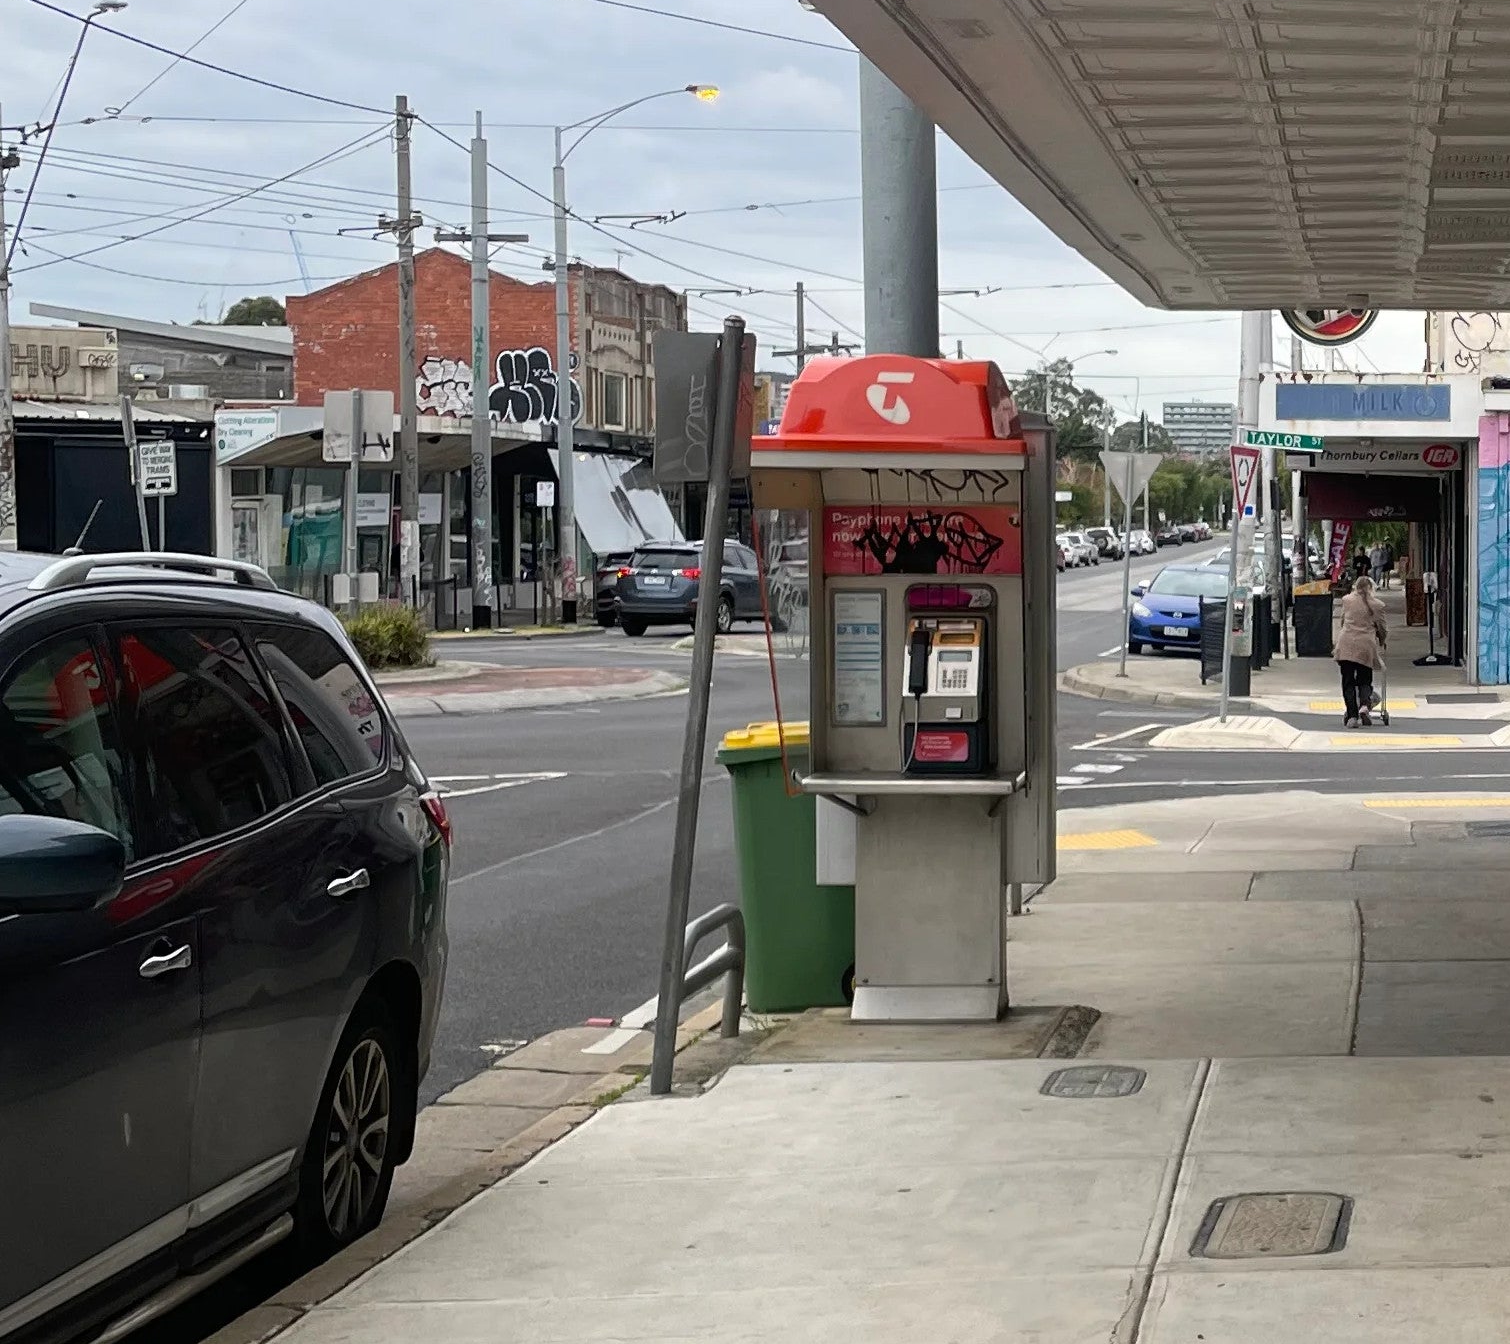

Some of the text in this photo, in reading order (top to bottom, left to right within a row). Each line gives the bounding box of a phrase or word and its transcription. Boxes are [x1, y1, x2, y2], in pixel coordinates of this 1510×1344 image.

[1352, 392, 1403, 412] MILK
[1249, 431, 1322, 448] TAYLOR ST
[1320, 448, 1455, 463] Thornbury Cellars IGA
